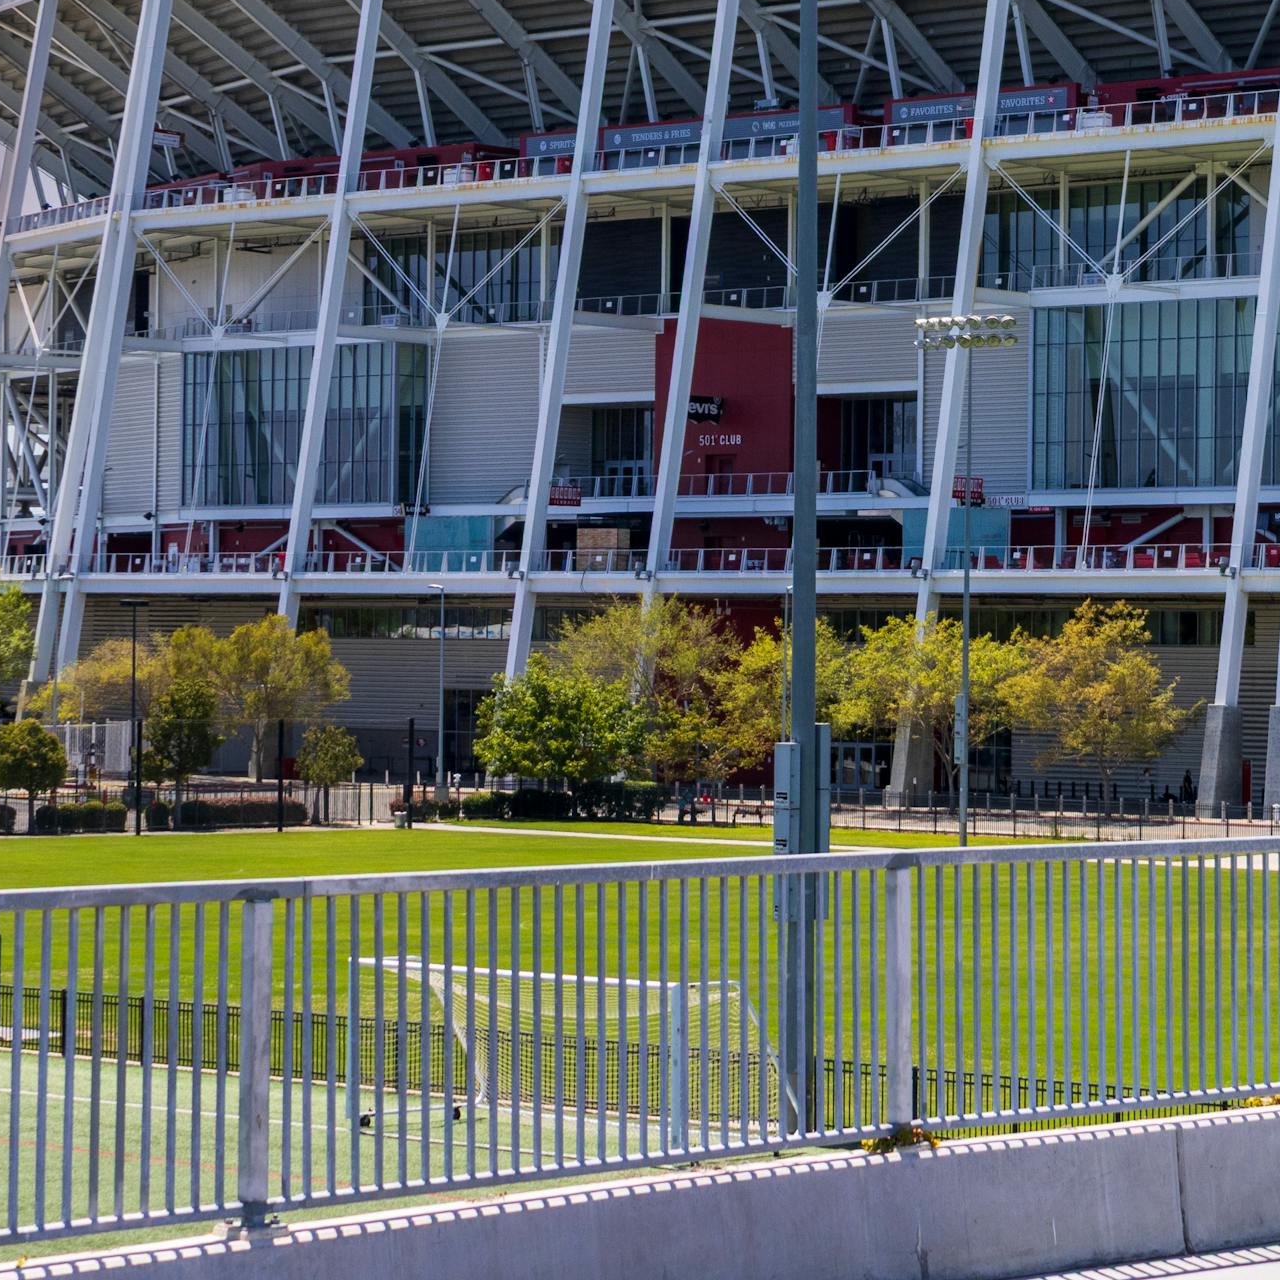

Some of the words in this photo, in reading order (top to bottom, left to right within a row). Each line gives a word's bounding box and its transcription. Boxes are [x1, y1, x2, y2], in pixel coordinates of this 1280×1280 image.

[1000, 95, 1045, 109] FAVORITES
[910, 104, 954, 117] FAVORITES
[631, 132, 665, 142] TENDERS
[671, 128, 691, 139] FRIES
[549, 138, 577, 150] SPIRITS
[719, 433, 742, 445] CLUB
